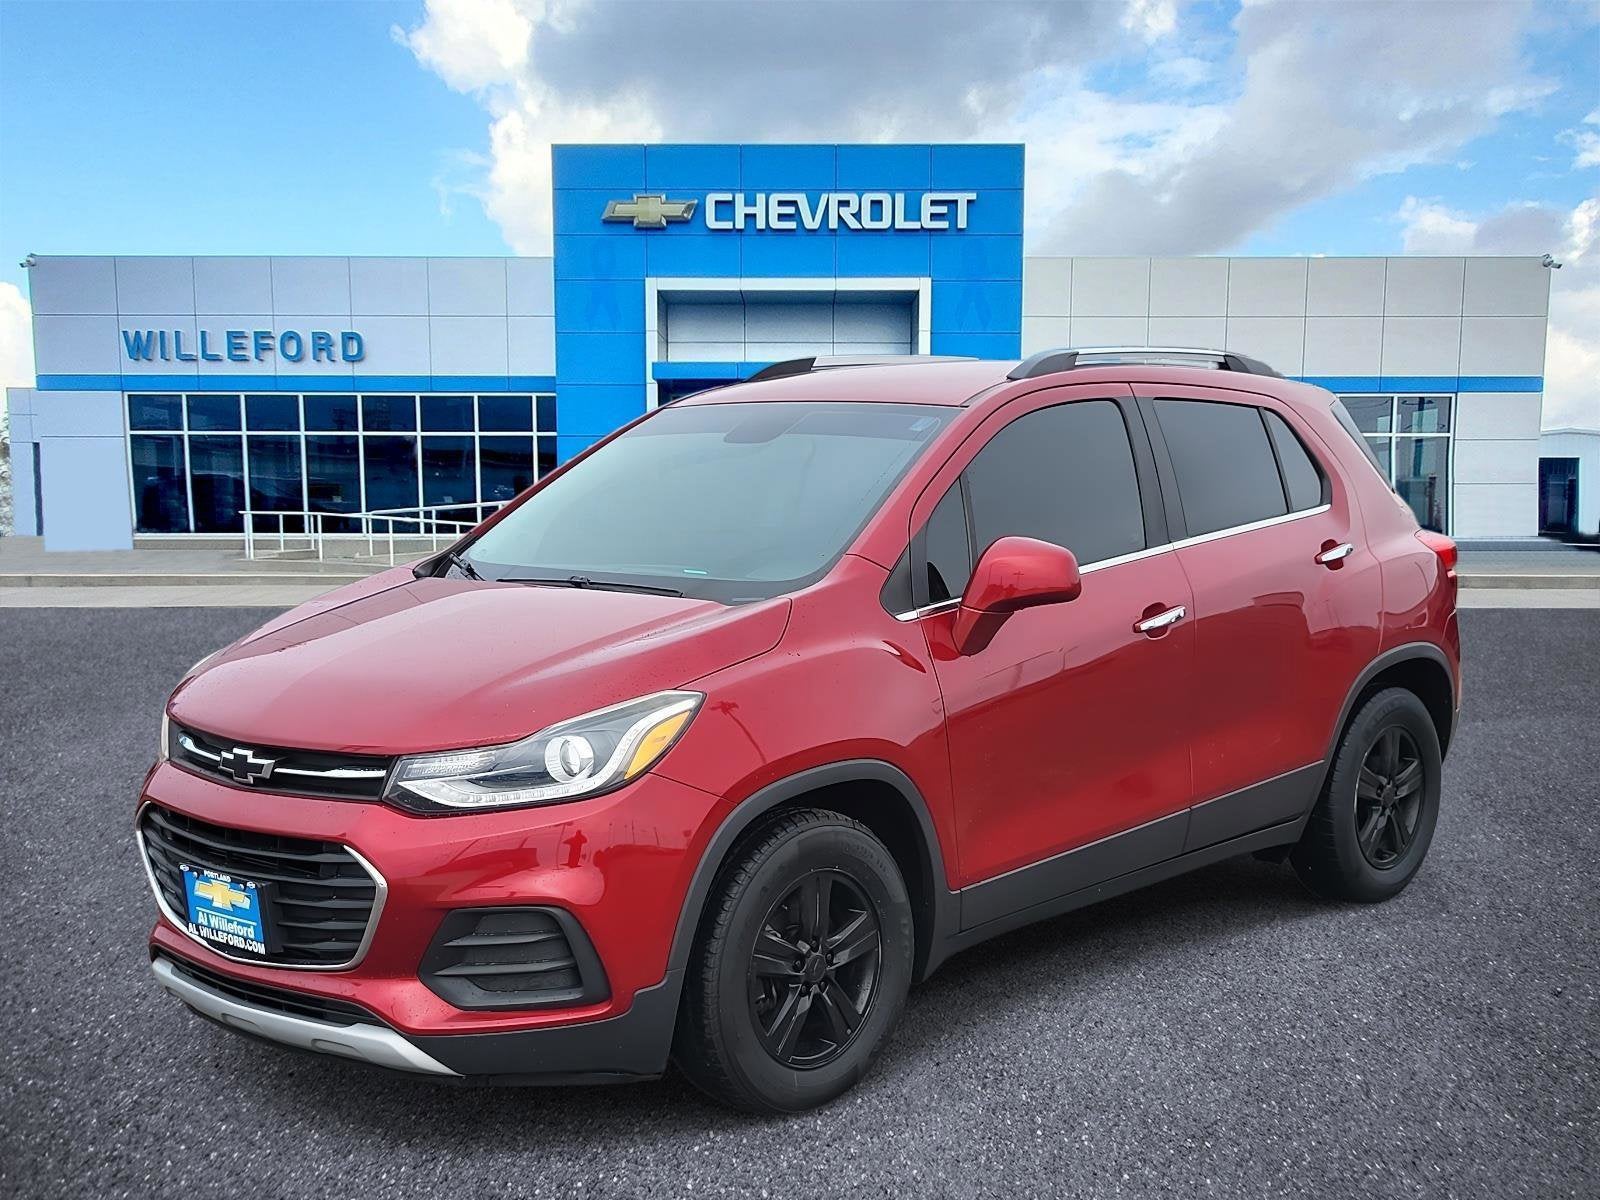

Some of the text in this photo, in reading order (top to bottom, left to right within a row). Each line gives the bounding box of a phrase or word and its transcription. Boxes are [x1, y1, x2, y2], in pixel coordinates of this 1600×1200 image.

[705, 193, 977, 229] CHEVROLET
[122, 330, 365, 362] WILLEFORD
[204, 870, 231, 882] PORTLAND
[188, 922, 266, 955] AL WILLEFORD.COM
[208, 914, 254, 939] Willeford
